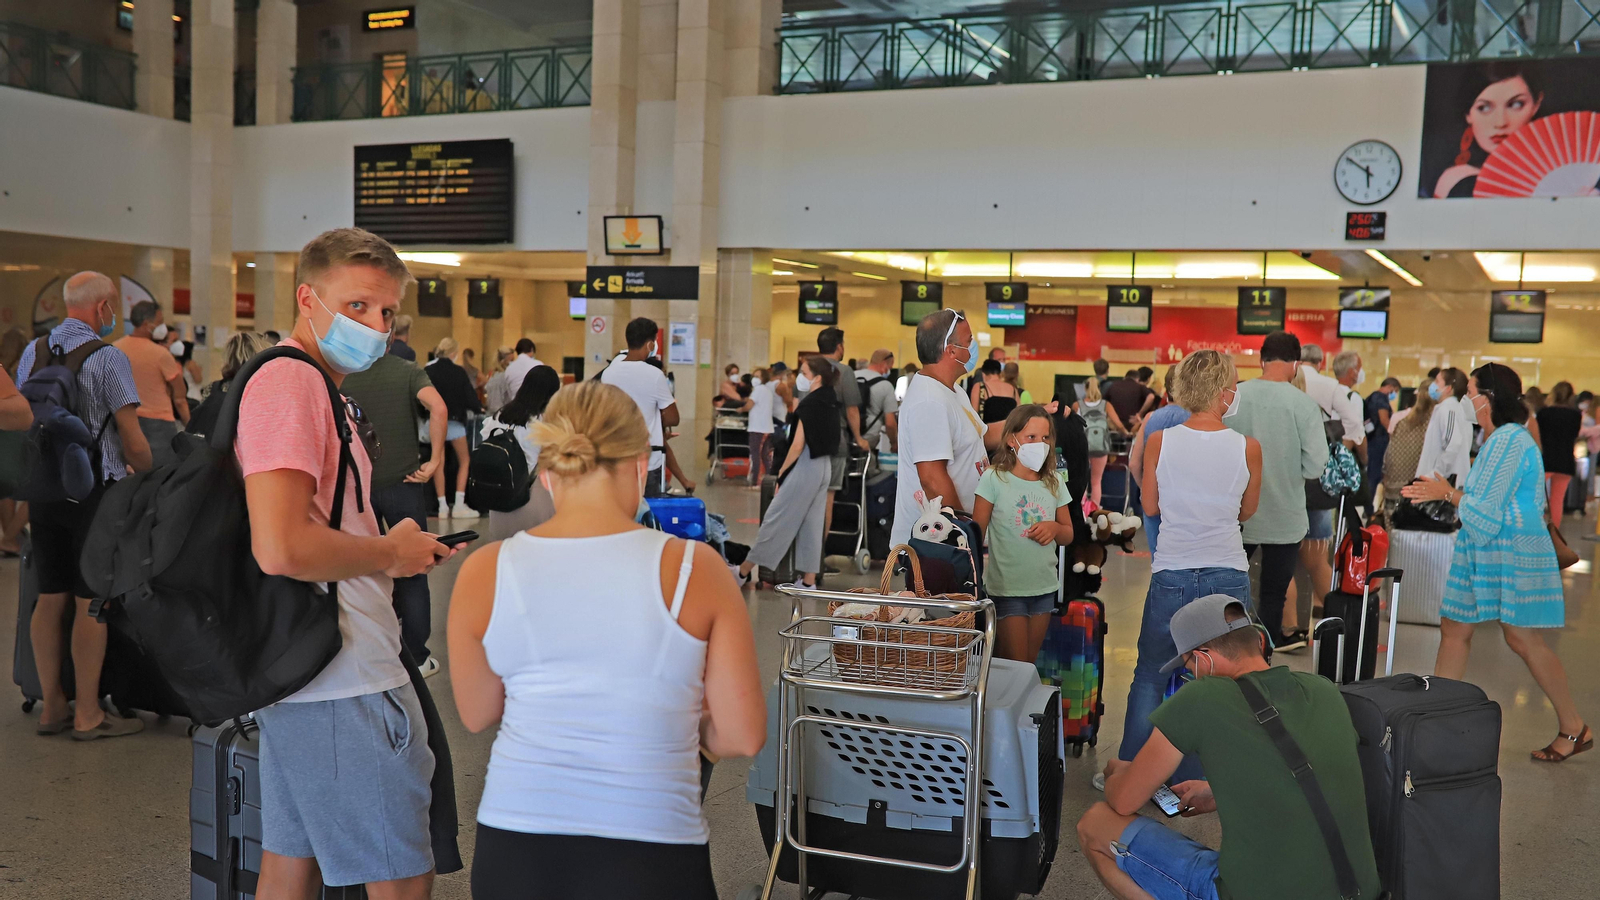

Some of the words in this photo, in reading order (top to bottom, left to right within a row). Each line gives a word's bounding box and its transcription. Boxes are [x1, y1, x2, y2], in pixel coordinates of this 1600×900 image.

[429, 280, 436, 294] 2
[480, 281, 488, 294] 3
[814, 284, 823, 297] 7
[917, 284, 927, 299] 8
[1002, 285, 1012, 300] 9
[1120, 288, 1140, 304] 10
[1251, 290, 1272, 306] 11
[1354, 290, 1375, 307] 12
[1288, 313, 1325, 322] IBERIA
